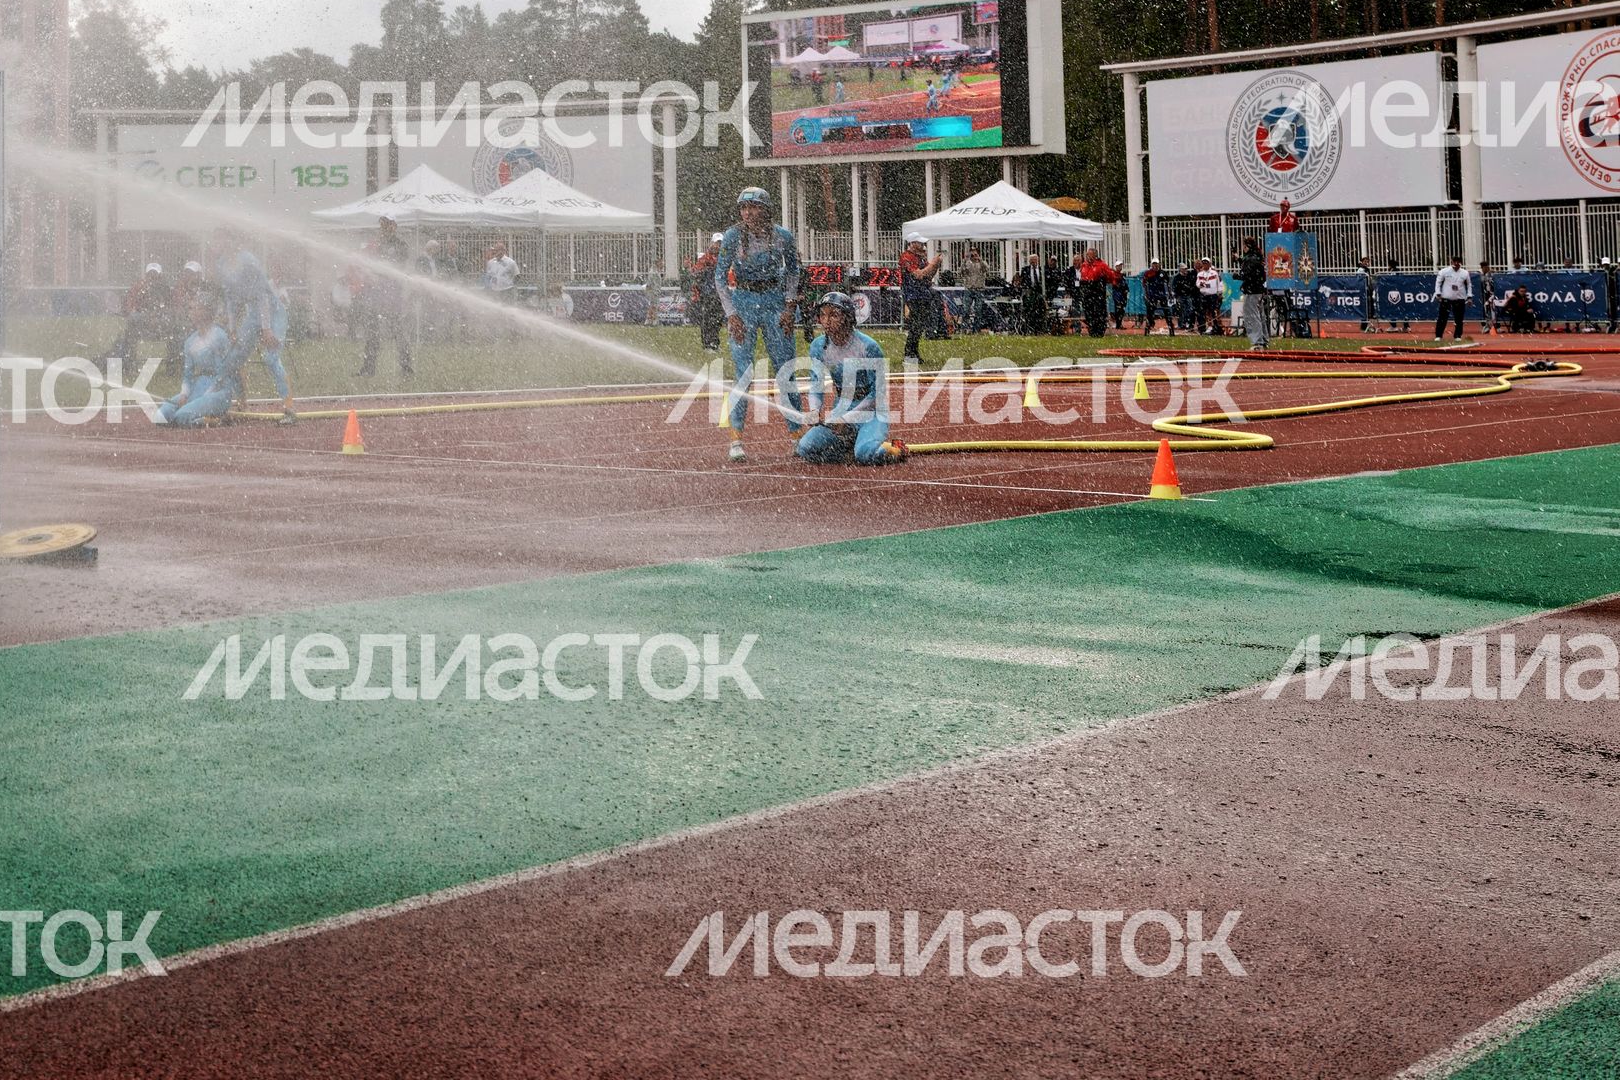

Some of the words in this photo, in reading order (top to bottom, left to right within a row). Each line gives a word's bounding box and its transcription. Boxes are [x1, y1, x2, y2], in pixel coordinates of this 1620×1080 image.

[1247, 76, 1294, 101] FEDERATION
[1295, 78, 1307, 87] OF
[1232, 100, 1247, 129] SPORT
[1308, 83, 1338, 143] IREFIGERS
[1232, 132, 1260, 193] INTERNATIONAL
[1562, 126, 1612, 183] ФЕДЕРАЦИЯ
[176, 166, 257, 188] СБЕР
[291, 164, 349, 188] 185
[1294, 165, 1331, 201] RESCUERS
[1262, 190, 1277, 201] THE
[1337, 296, 1361, 307] ПСБ
